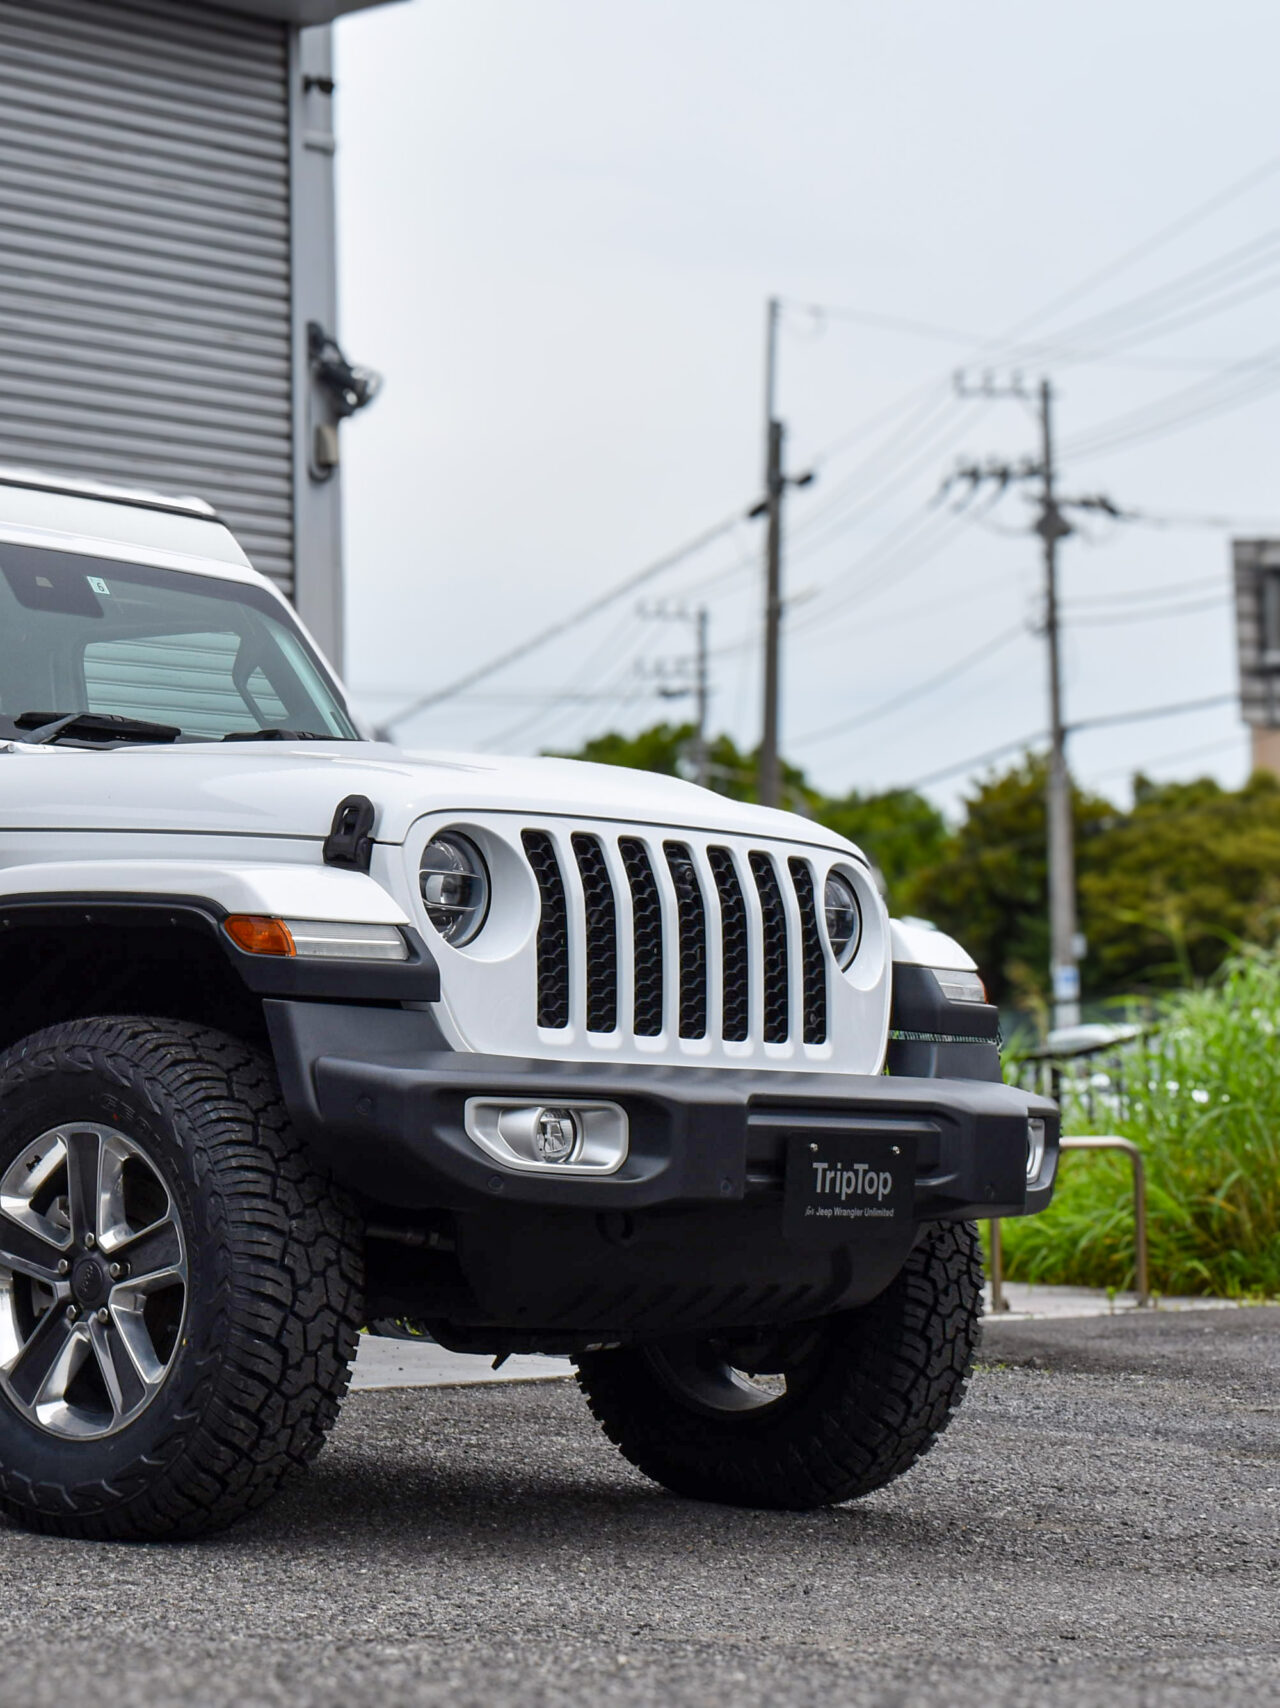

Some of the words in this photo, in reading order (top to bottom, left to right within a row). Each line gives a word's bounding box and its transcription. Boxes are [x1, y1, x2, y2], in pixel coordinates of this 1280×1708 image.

[812, 1162, 892, 1202] TripTop
[816, 1207, 832, 1218] Jeep
[834, 1207, 863, 1218] Wrangler
[864, 1208, 894, 1217] Unlimited
